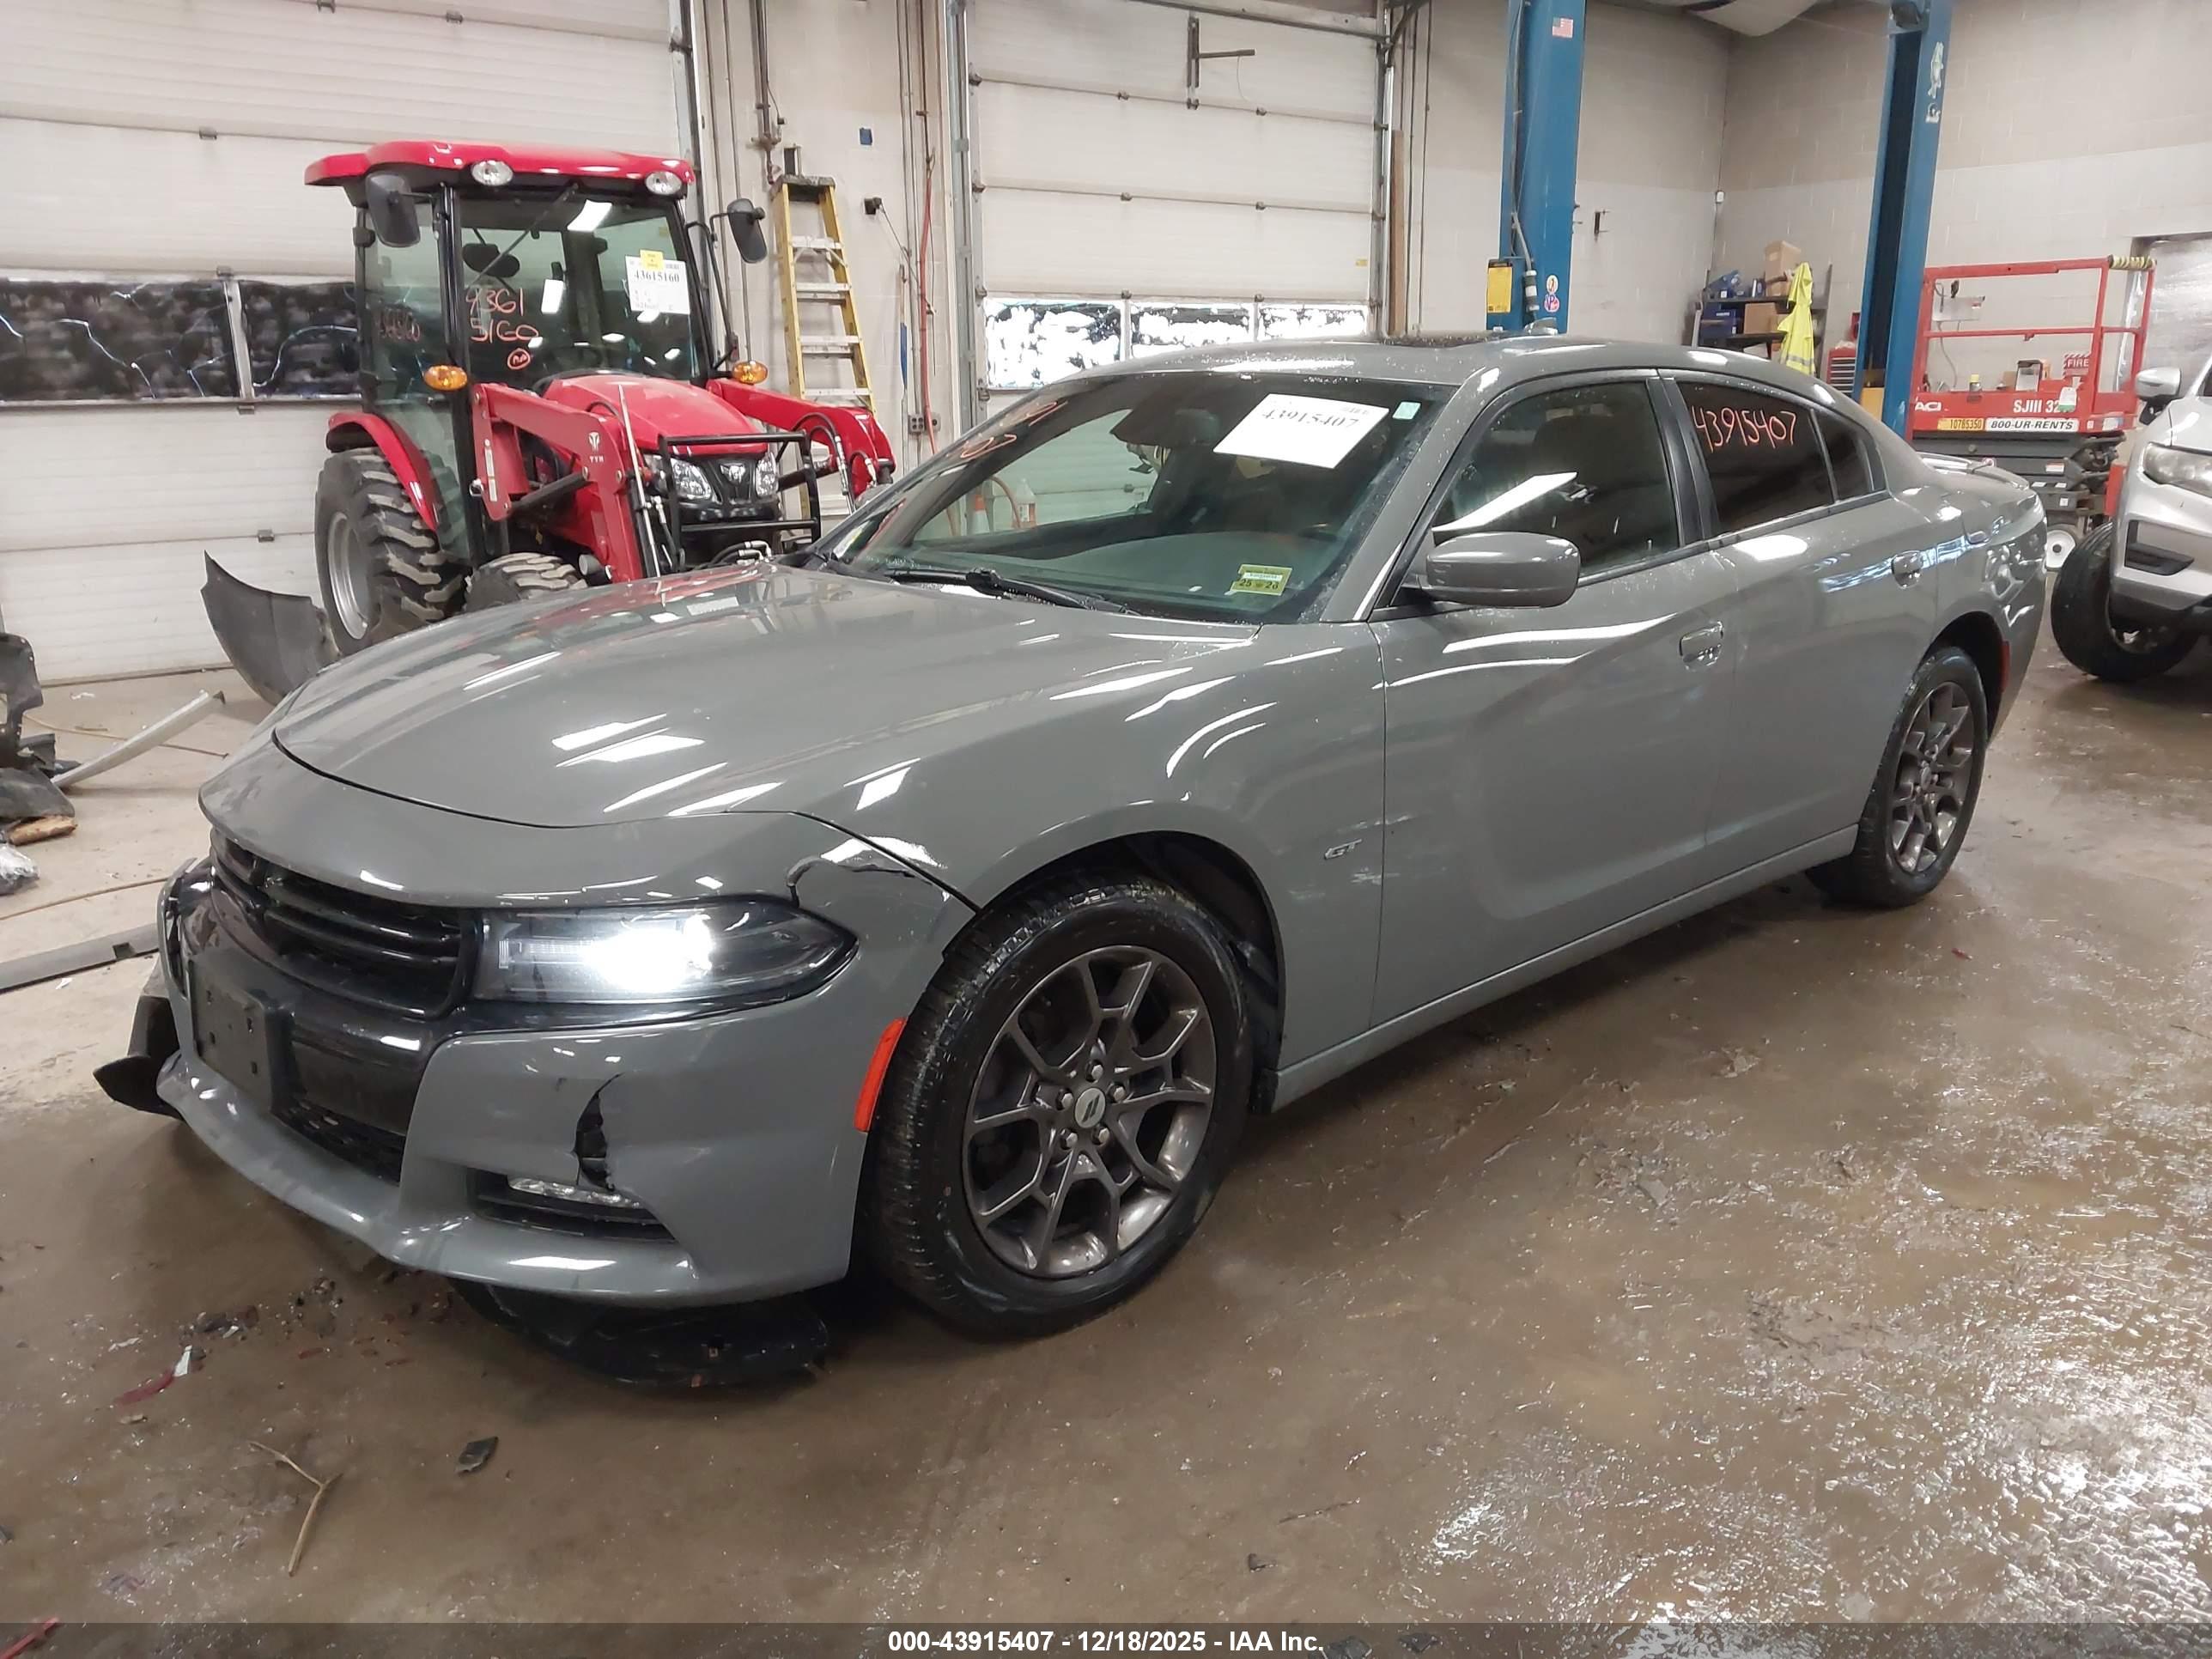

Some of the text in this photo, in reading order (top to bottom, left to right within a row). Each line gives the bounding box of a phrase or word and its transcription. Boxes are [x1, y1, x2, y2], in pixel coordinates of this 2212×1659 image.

[635, 270, 680, 283] 43615160
[465, 288, 524, 317] 4361
[470, 318, 539, 343] 5160
[2067, 358, 2089, 368] FIRE
[2013, 399, 2043, 413] SJIII
[1262, 409, 1359, 428] 43915407
[1991, 421, 2074, 429] 800-UR-RENTS
[1692, 405, 1796, 453] 43915407
[1324, 838, 1362, 860] GT
